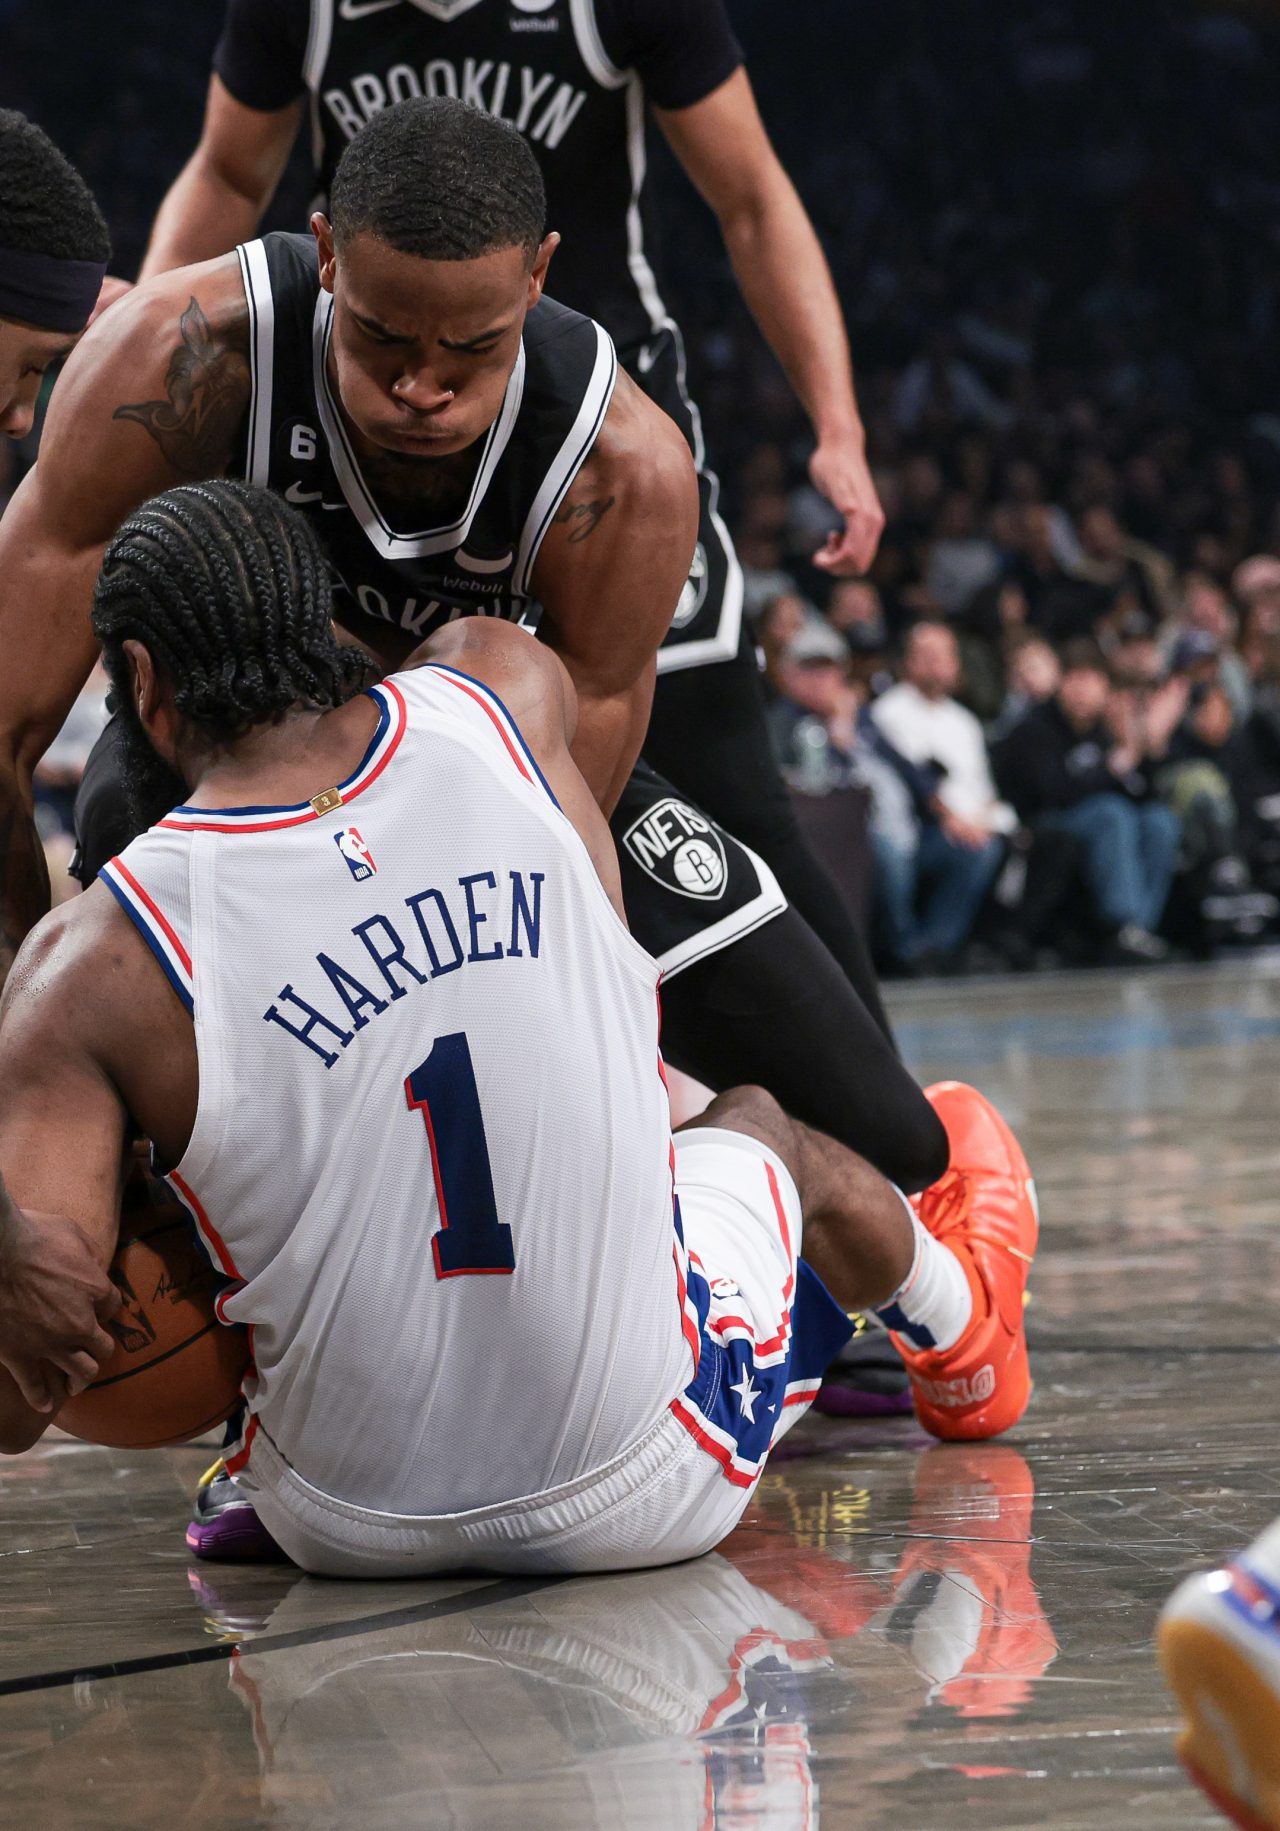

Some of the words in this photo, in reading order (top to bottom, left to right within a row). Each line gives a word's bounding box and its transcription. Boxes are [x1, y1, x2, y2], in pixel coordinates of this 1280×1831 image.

[323, 57, 587, 150] BROOKLYN
[290, 423, 317, 460] 6
[442, 575, 504, 594] Webull
[631, 803, 710, 870] NETS
[354, 865, 370, 880] NBA
[686, 849, 714, 885] B
[263, 871, 545, 1069] HARDEN
[404, 1031, 516, 1280] 1
